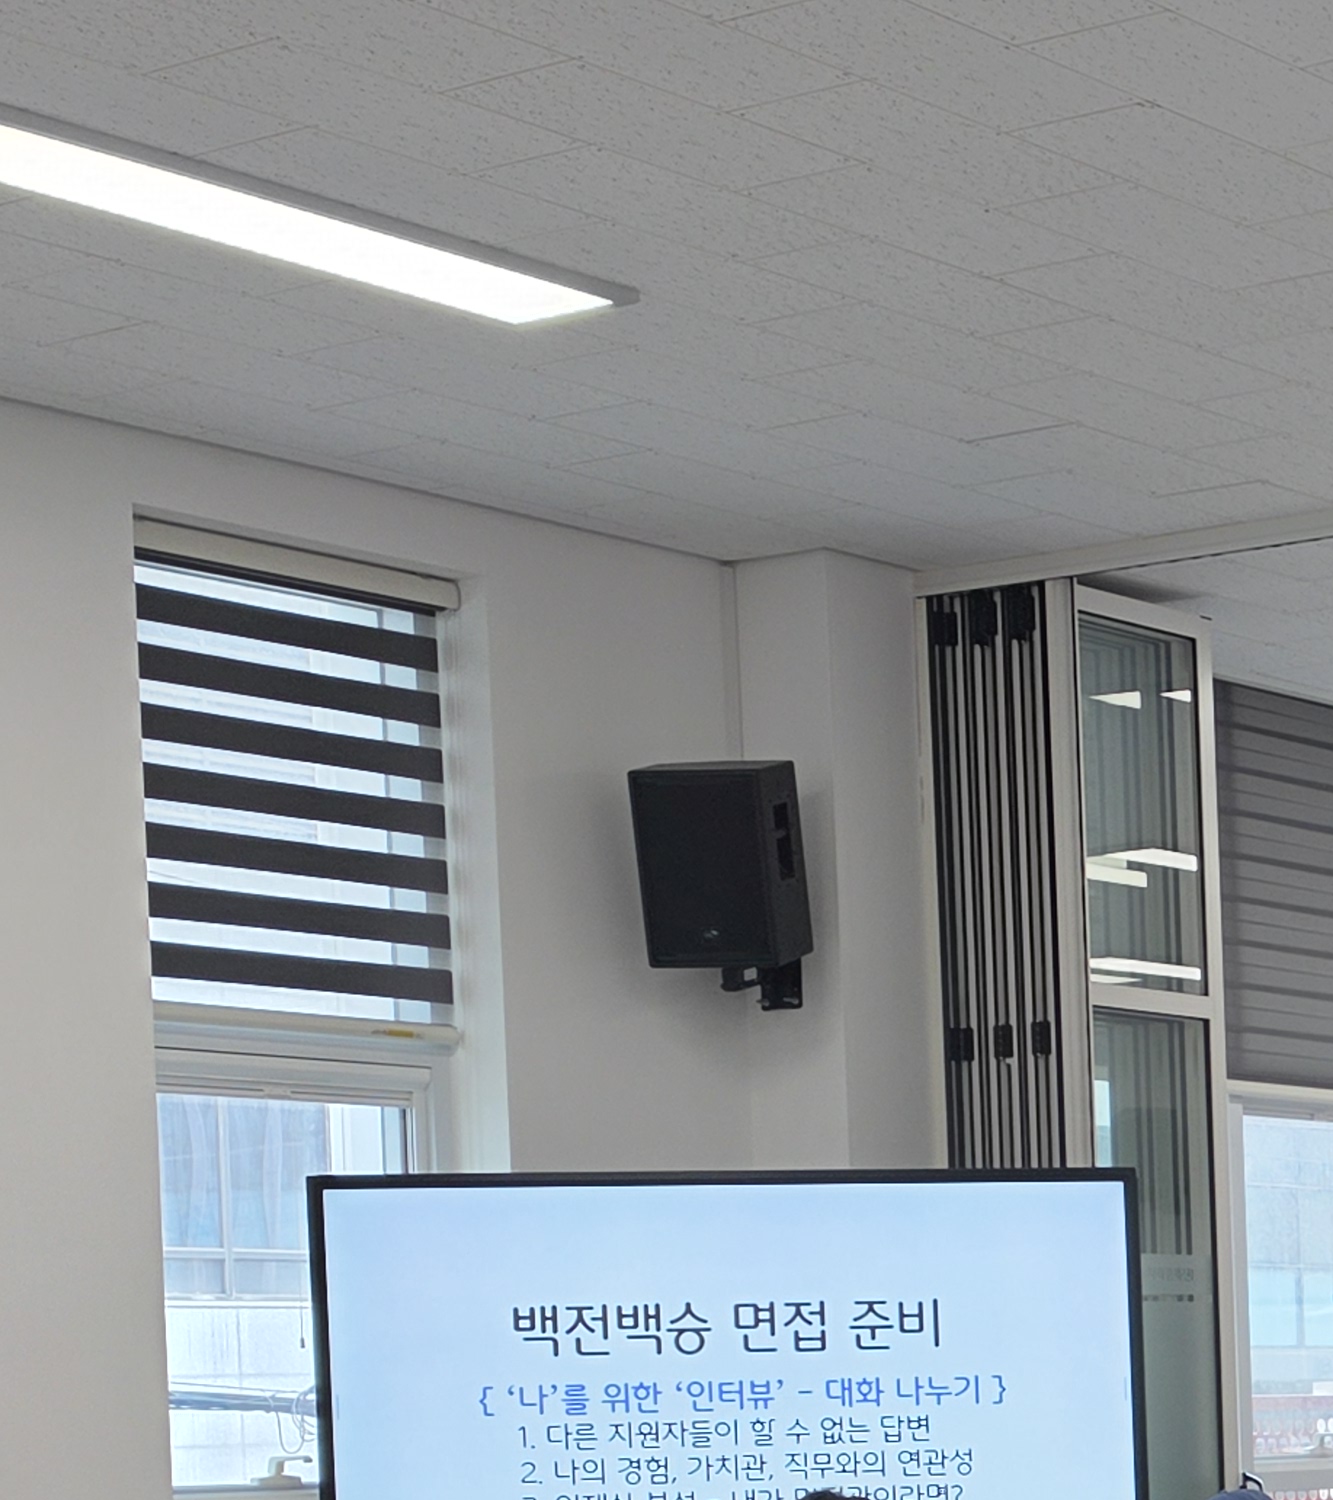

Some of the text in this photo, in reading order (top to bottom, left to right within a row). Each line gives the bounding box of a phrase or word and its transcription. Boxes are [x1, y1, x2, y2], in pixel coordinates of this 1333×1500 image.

[512, 1298, 940, 1357] 백전백승 면접 준비
[479, 1386, 496, 1416] {
[601, 1381, 663, 1414] 위한
[675, 1379, 784, 1412] ‘인터뷰’
[825, 1377, 885, 1407] 대화
[896, 1374, 980, 1405] 나누기
[991, 1375, 1007, 1405] }
[517, 1414, 930, 1451] 1. 다른 지원자들이 할 수 없는 답변
[521, 1448, 974, 1486] 2. 나의 경험, 가치관, 직무와의 연관성
